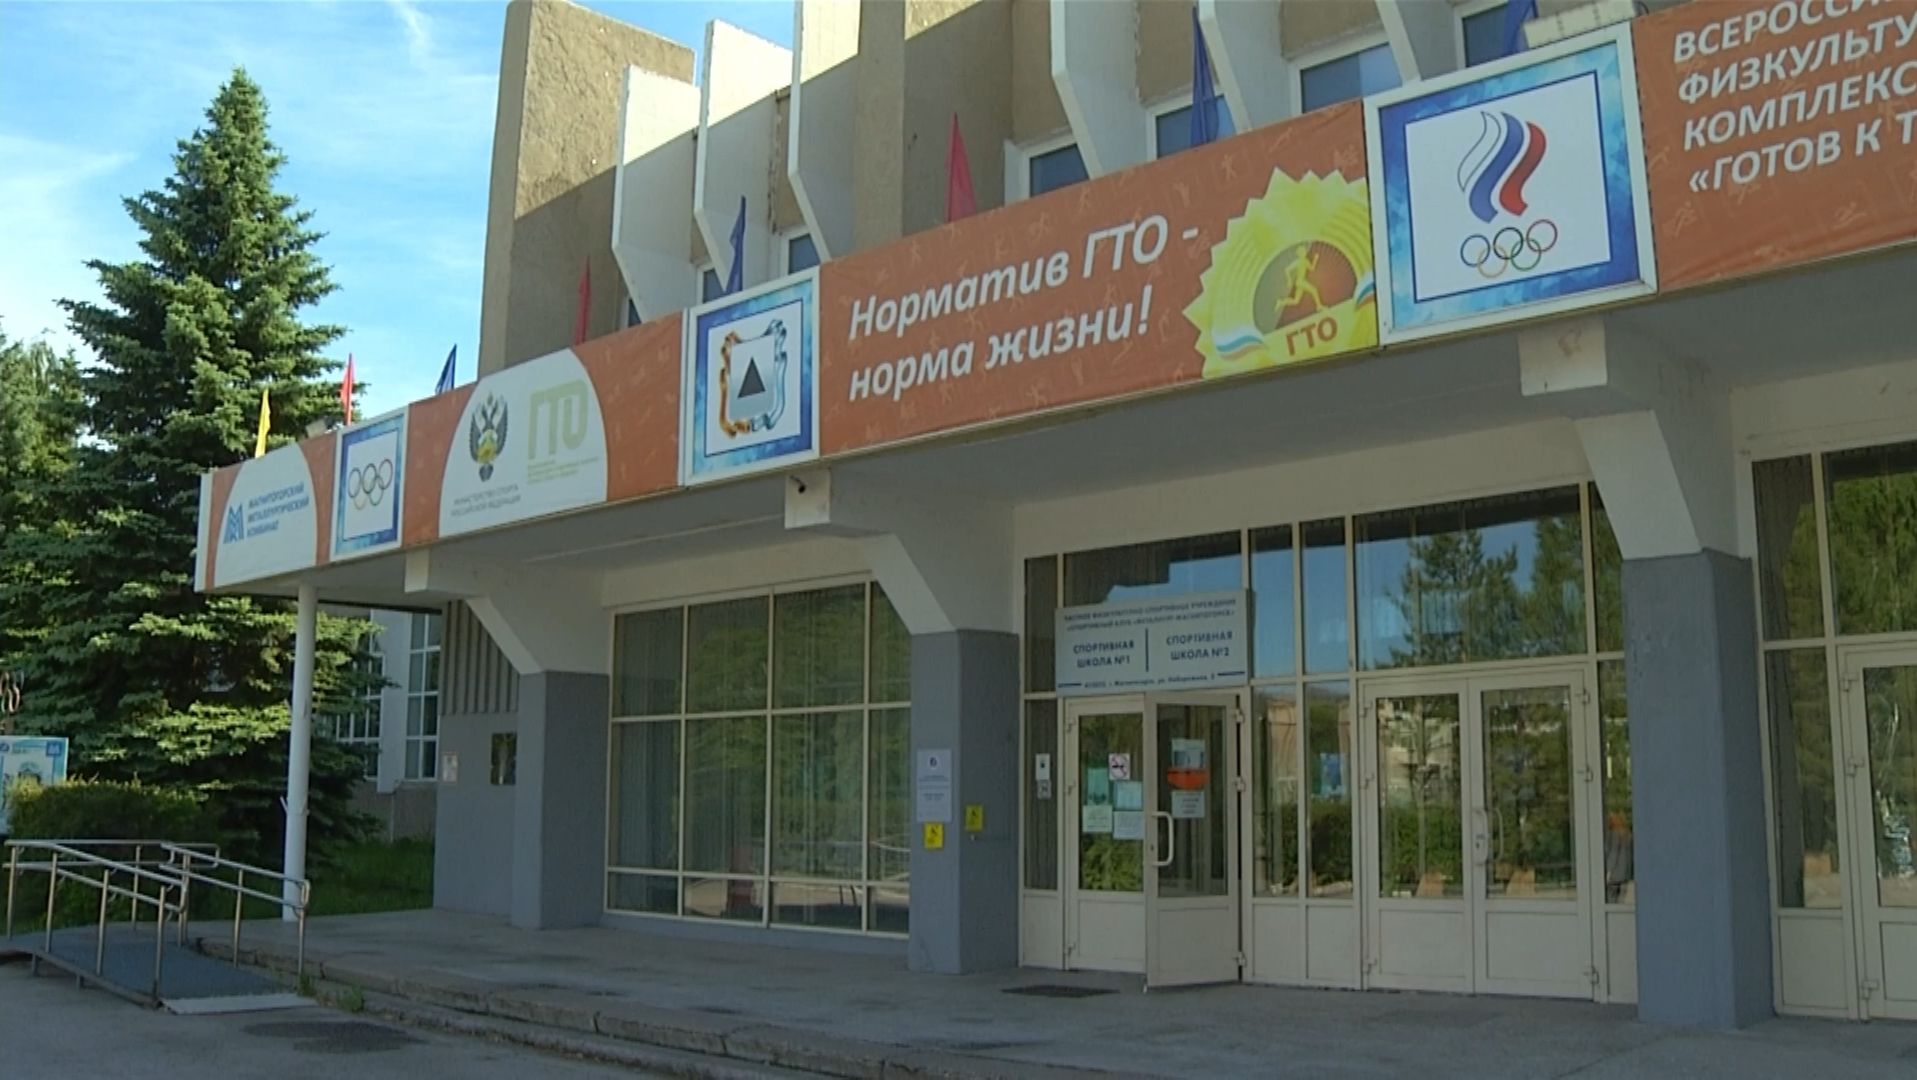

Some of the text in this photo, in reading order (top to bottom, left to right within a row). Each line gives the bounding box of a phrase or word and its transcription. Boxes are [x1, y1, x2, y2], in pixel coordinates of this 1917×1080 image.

[1682, 61, 1917, 151] КОМПЛЕКС
[1688, 130, 1842, 193] «ГОТОВ
[1854, 118, 1882, 156] К
[847, 250, 1069, 342] Норматив
[1082, 213, 1170, 279] ГТО
[847, 284, 1153, 403] норма жизни!
[1284, 315, 1339, 357] ГТО
[248, 481, 305, 508] МАГНИТОГОРСКИЙ
[247, 496, 310, 523] МЕТАЛЛУРГИЧЕСКИЙ
[1073, 640, 1135, 654] СПОРТИВНАЯ
[1166, 630, 1233, 646] СПОРТИВНАЯ
[1077, 655, 1131, 668] ШКОЛА №1
[1170, 646, 1230, 661] ШКОЛА №2
